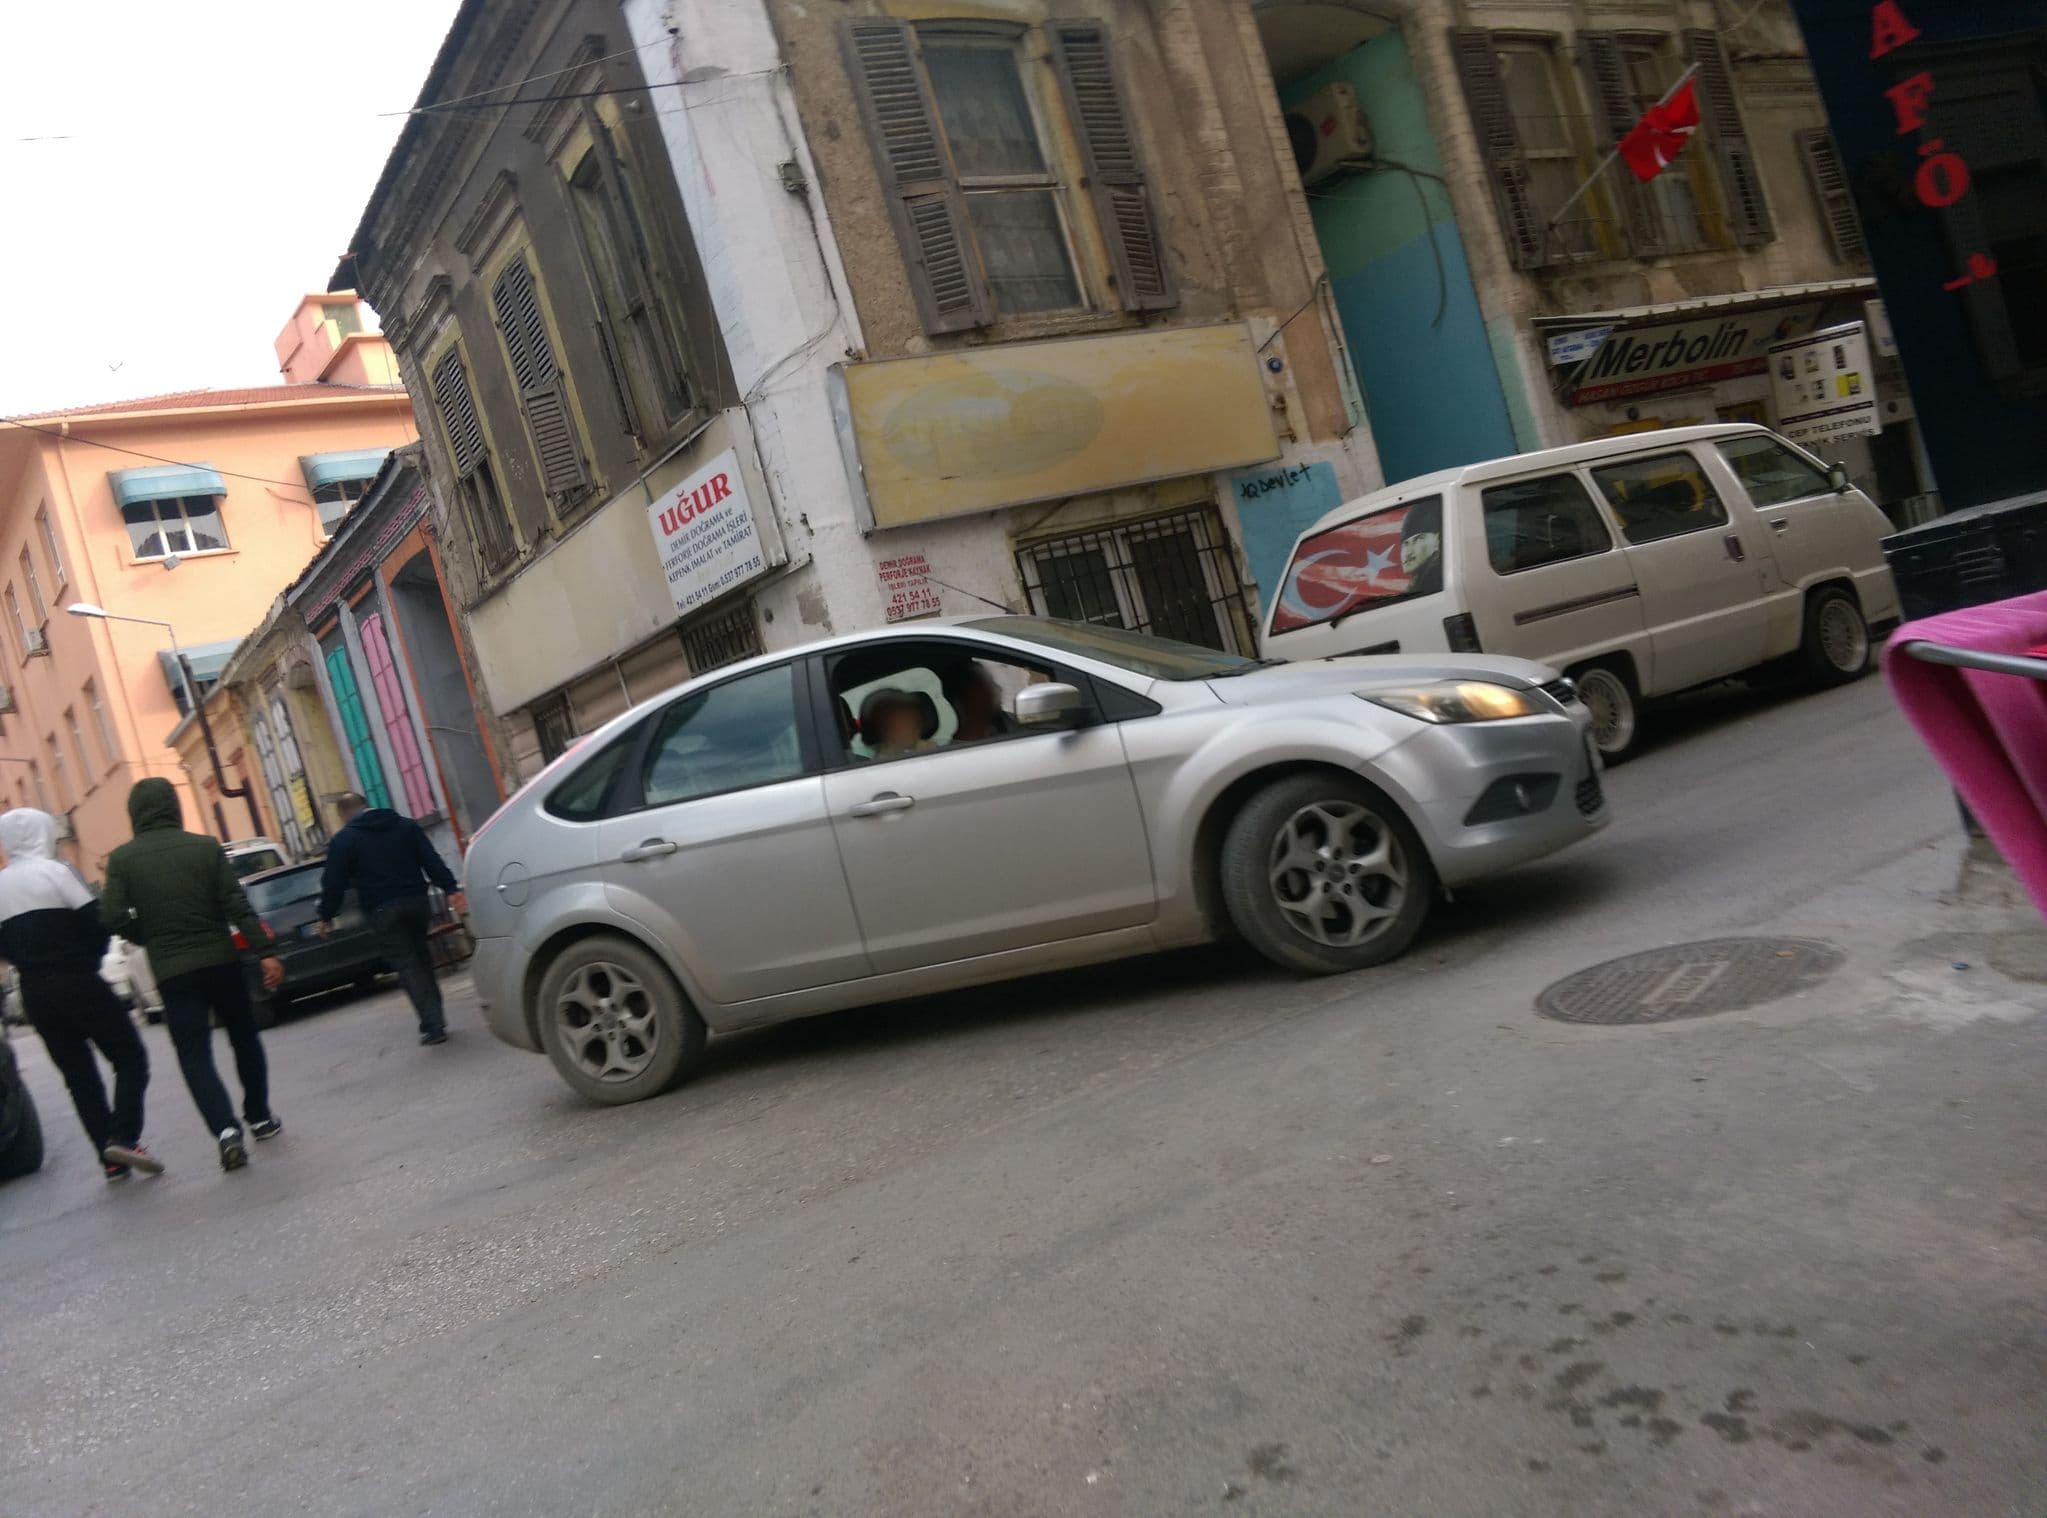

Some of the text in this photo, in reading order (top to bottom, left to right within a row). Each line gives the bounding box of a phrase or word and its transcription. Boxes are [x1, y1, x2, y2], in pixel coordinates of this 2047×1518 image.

[1590, 322, 1749, 380] Merbolin
[1788, 415, 1871, 439] CEP TELEFONU
[658, 472, 732, 536] UĞUR
[690, 511, 724, 538] DOĞRAMA
[724, 507, 734, 518] ve
[692, 526, 727, 553] DOĞRAMA
[726, 509, 748, 533] İŞLERİ
[714, 545, 722, 555] ve
[722, 525, 752, 550] TAMİRAT
[686, 594, 695, 605] 421
[734, 564, 745, 578] 977
[744, 560, 753, 572] 78
[752, 555, 761, 567] 55
[892, 587, 931, 604] 421 54 11
[886, 596, 941, 617] 0537 977 78 55
